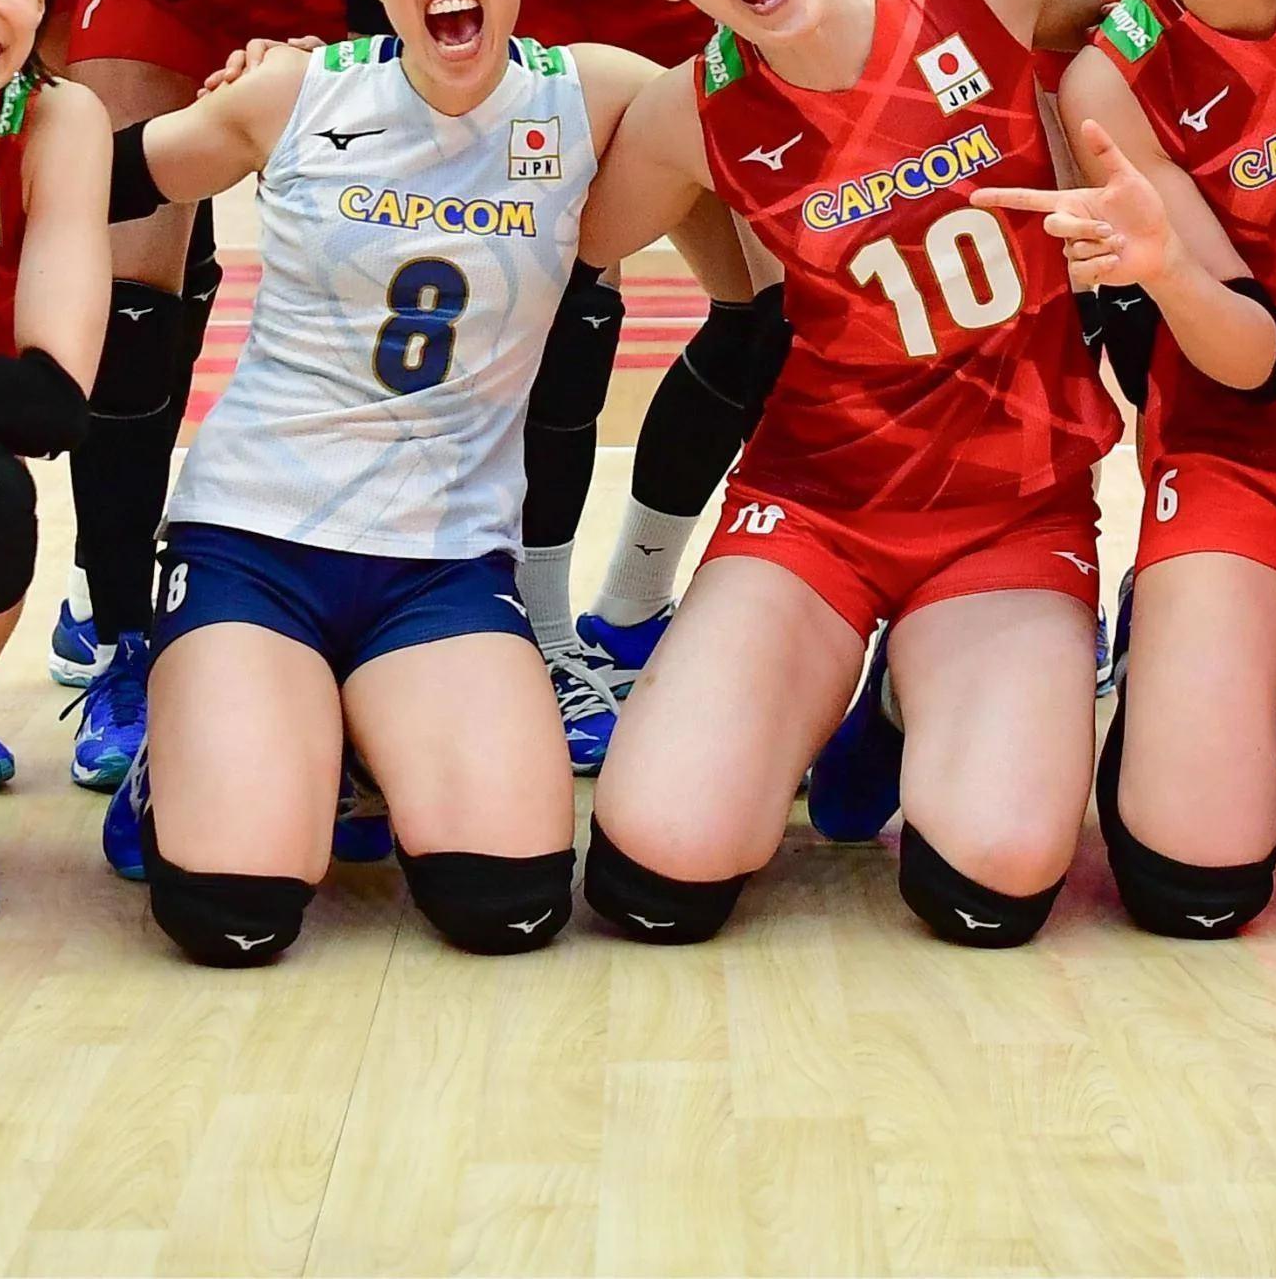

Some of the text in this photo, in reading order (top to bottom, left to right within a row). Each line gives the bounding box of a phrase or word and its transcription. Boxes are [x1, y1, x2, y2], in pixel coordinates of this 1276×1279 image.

[949, 77, 982, 107] JPN
[518, 160, 552, 176] JPN
[803, 124, 1003, 232] CAPCOM
[338, 184, 537, 237] CAPCOM
[849, 208, 1023, 357] 10
[372, 256, 470, 397] 8
[1155, 469, 1180, 522] 6
[166, 562, 188, 612] 8
